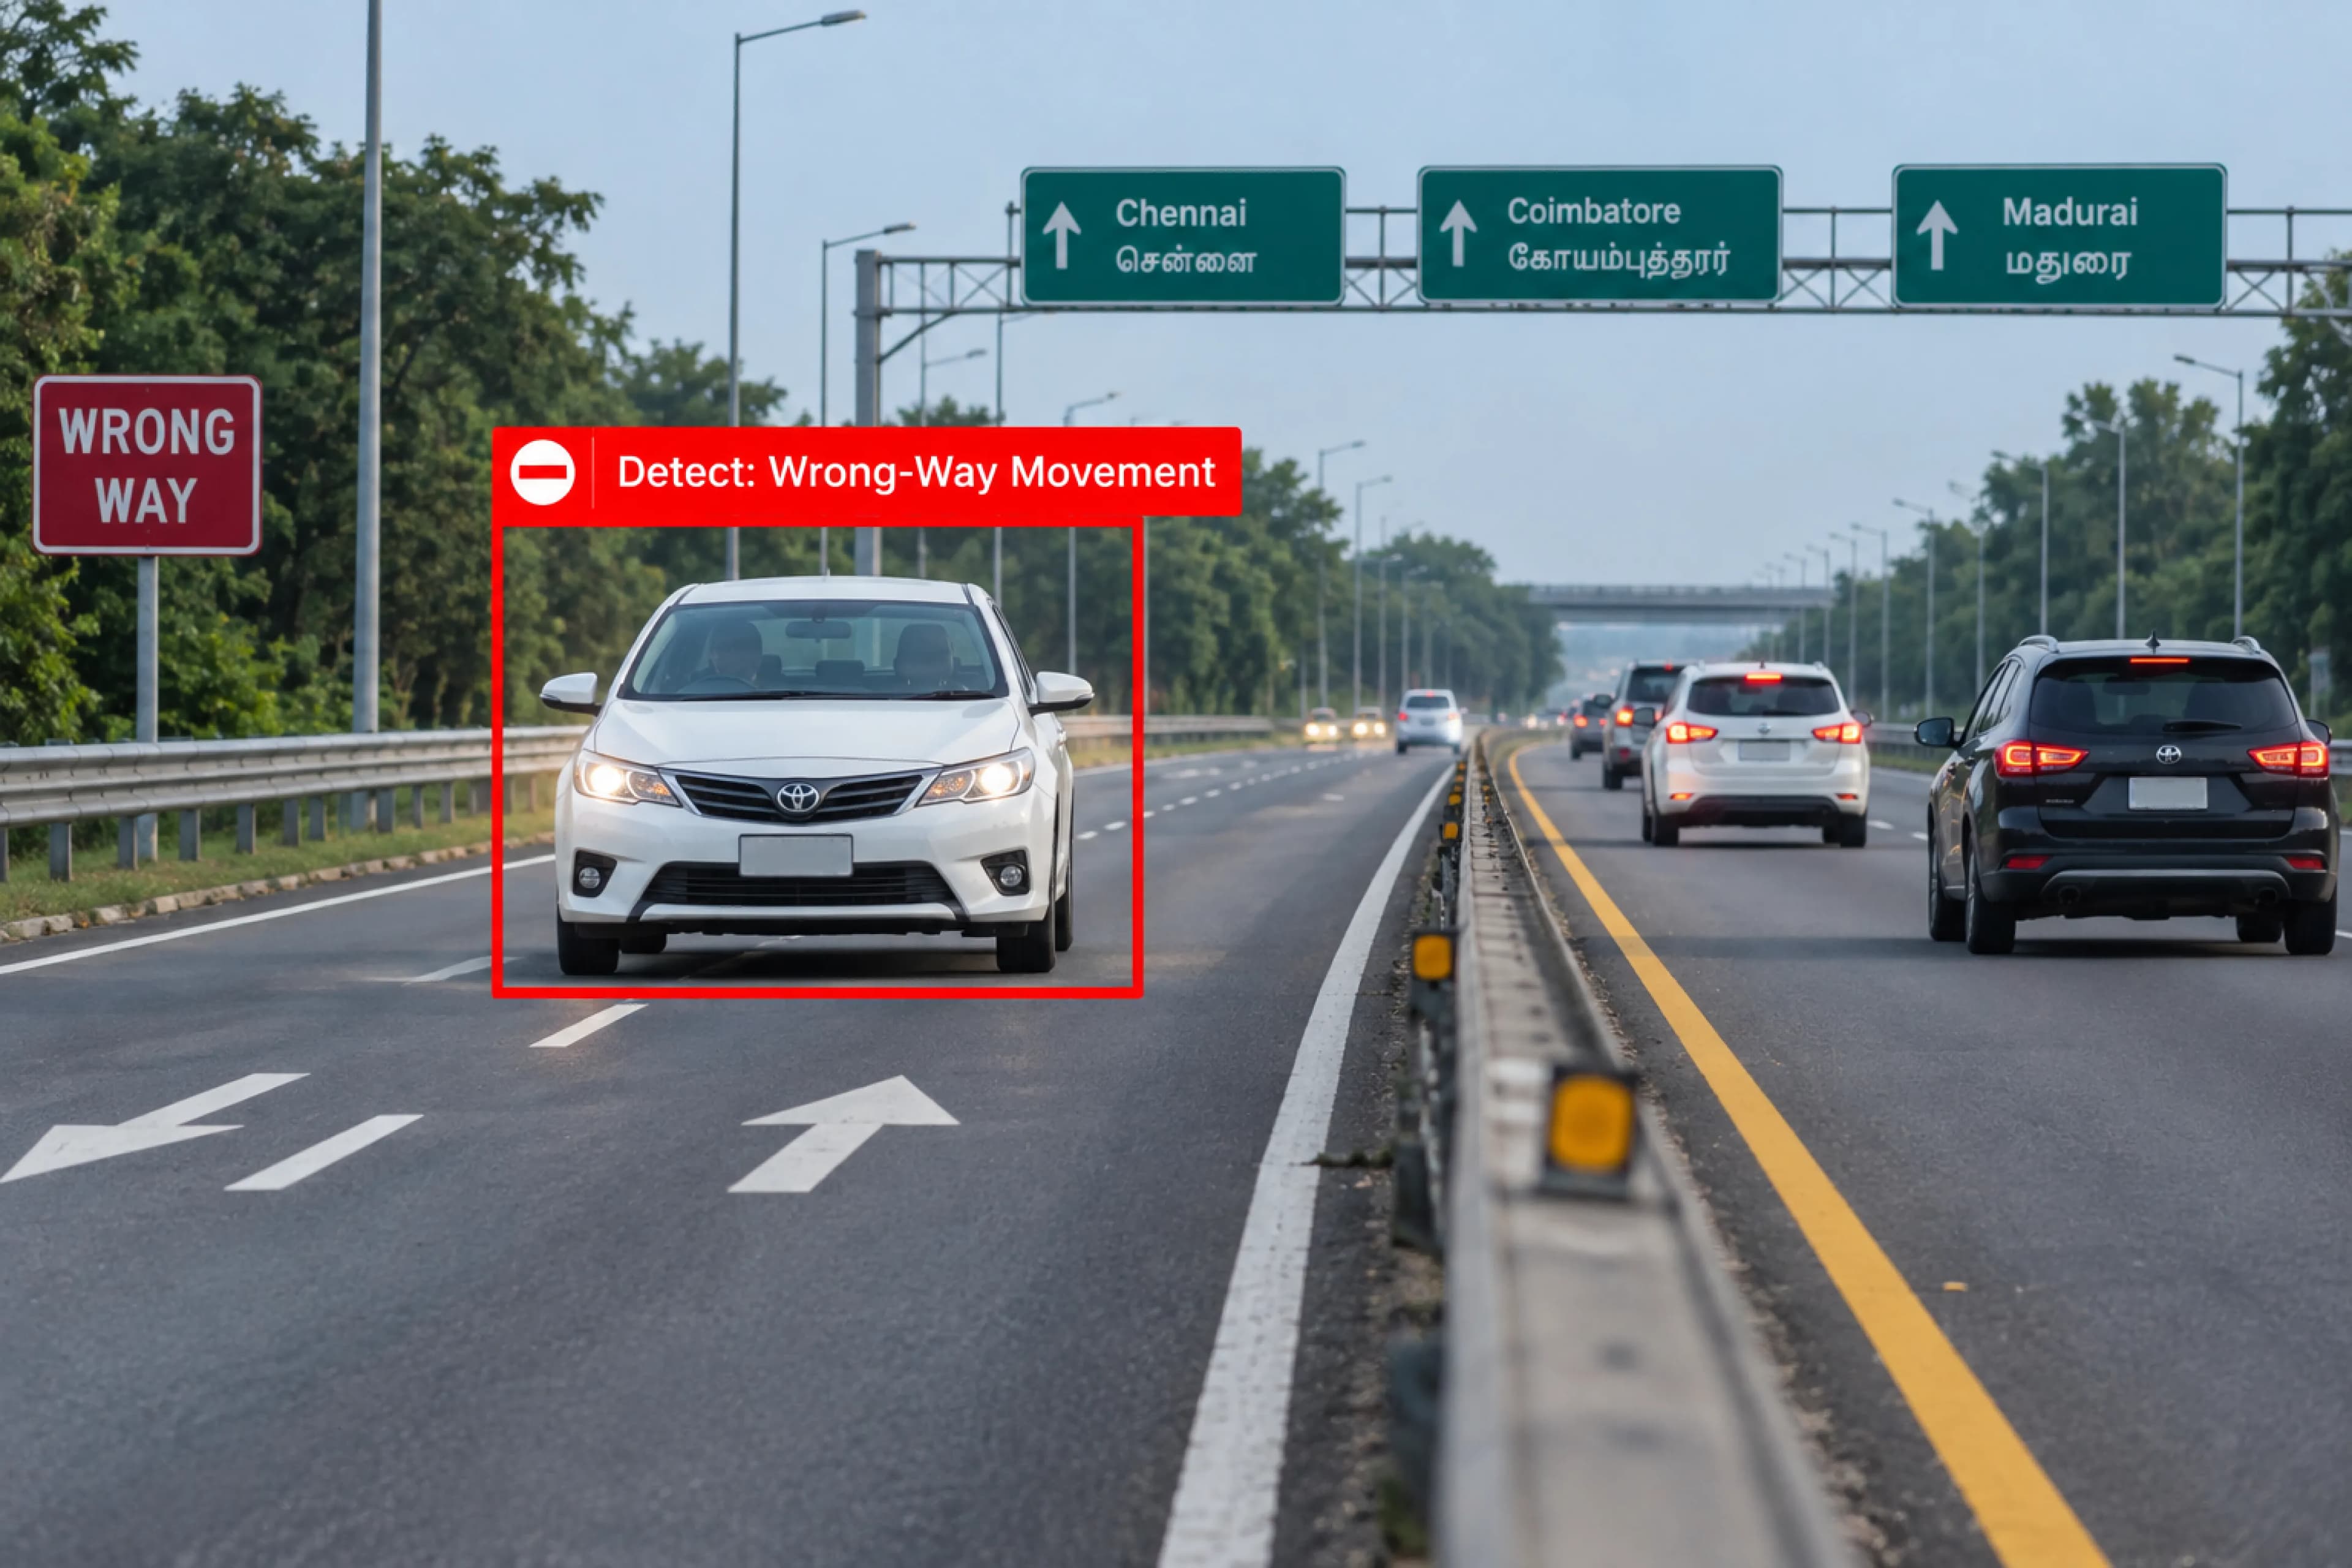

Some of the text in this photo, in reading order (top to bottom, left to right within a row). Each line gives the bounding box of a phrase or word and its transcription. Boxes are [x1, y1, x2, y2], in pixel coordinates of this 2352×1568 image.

[1116, 198, 1246, 227] Chennai
[1508, 196, 1681, 224] Coimbatore
[2003, 196, 2137, 226] Madurai
[1116, 244, 1257, 273] சென்னை
[2007, 252, 2132, 285] மதுரை
[58, 408, 235, 455] WRONG
[94, 477, 198, 523] WAY
